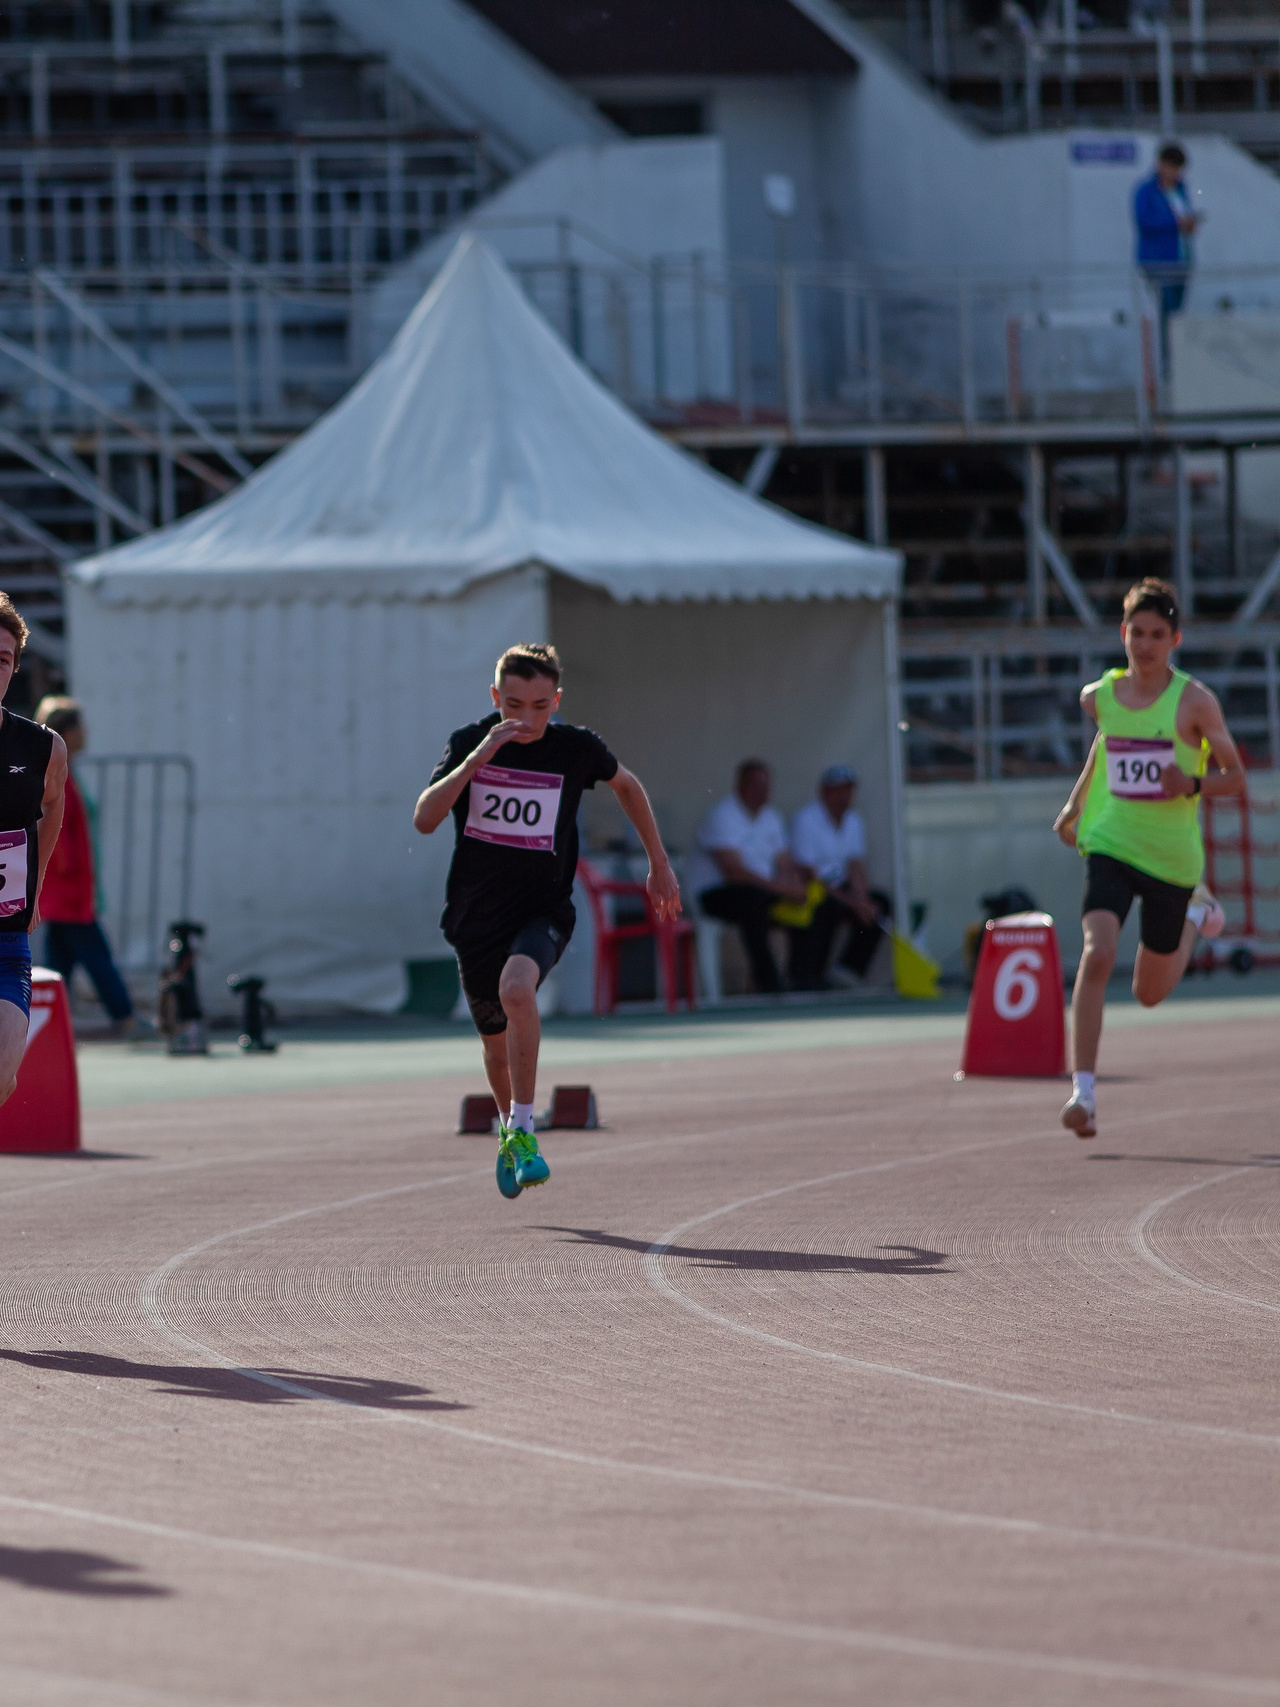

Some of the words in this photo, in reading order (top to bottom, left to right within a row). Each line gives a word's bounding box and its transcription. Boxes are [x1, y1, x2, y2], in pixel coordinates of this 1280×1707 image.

[1117, 758, 1160, 784] 190
[481, 793, 541, 826] 200
[993, 948, 1044, 1022] 6
